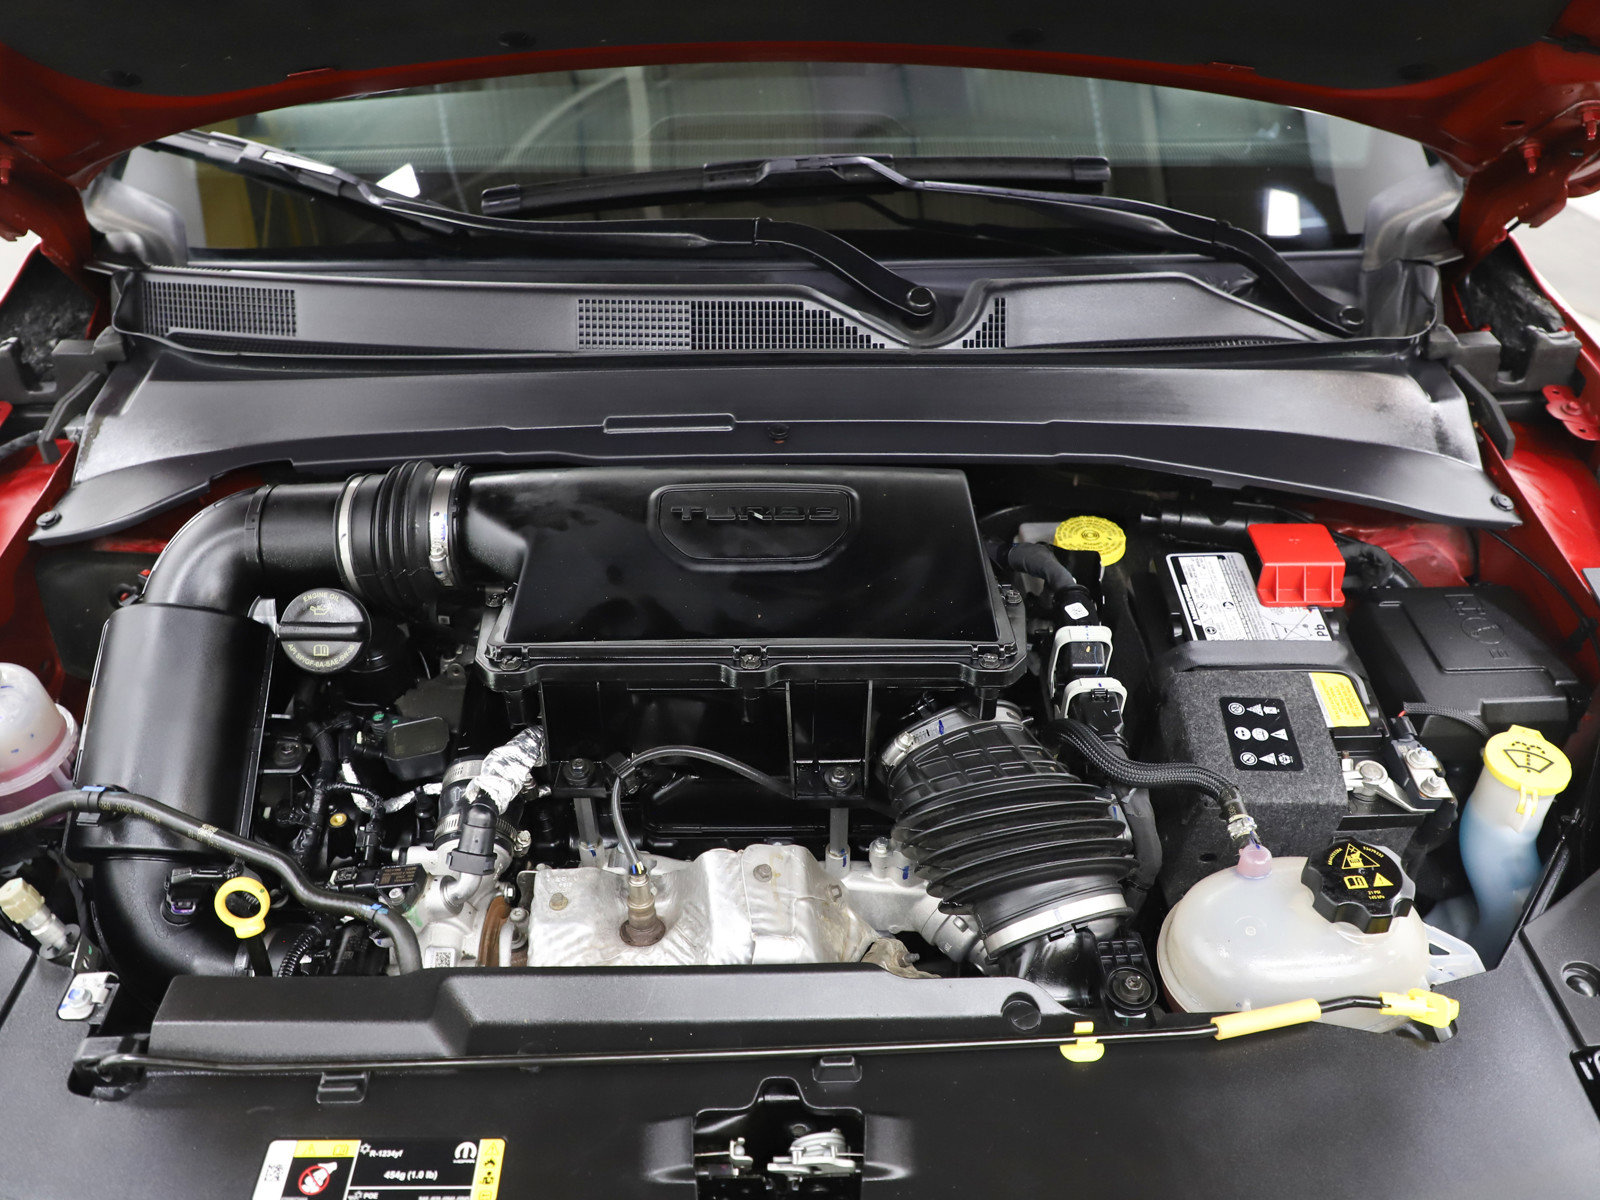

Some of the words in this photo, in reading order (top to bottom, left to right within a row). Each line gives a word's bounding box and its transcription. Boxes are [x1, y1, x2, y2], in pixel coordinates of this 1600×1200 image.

[670, 506, 840, 521] TURBO
[303, 592, 328, 602] ENGINE
[329, 593, 340, 602] OIL
[1314, 623, 1329, 637] Pb
[287, 643, 298, 655] API
[369, 1149, 404, 1159] R-1234yf
[383, 1170, 406, 1181] 454g
[407, 1170, 425, 1181] (1.0
[425, 1170, 438, 1181] lb)
